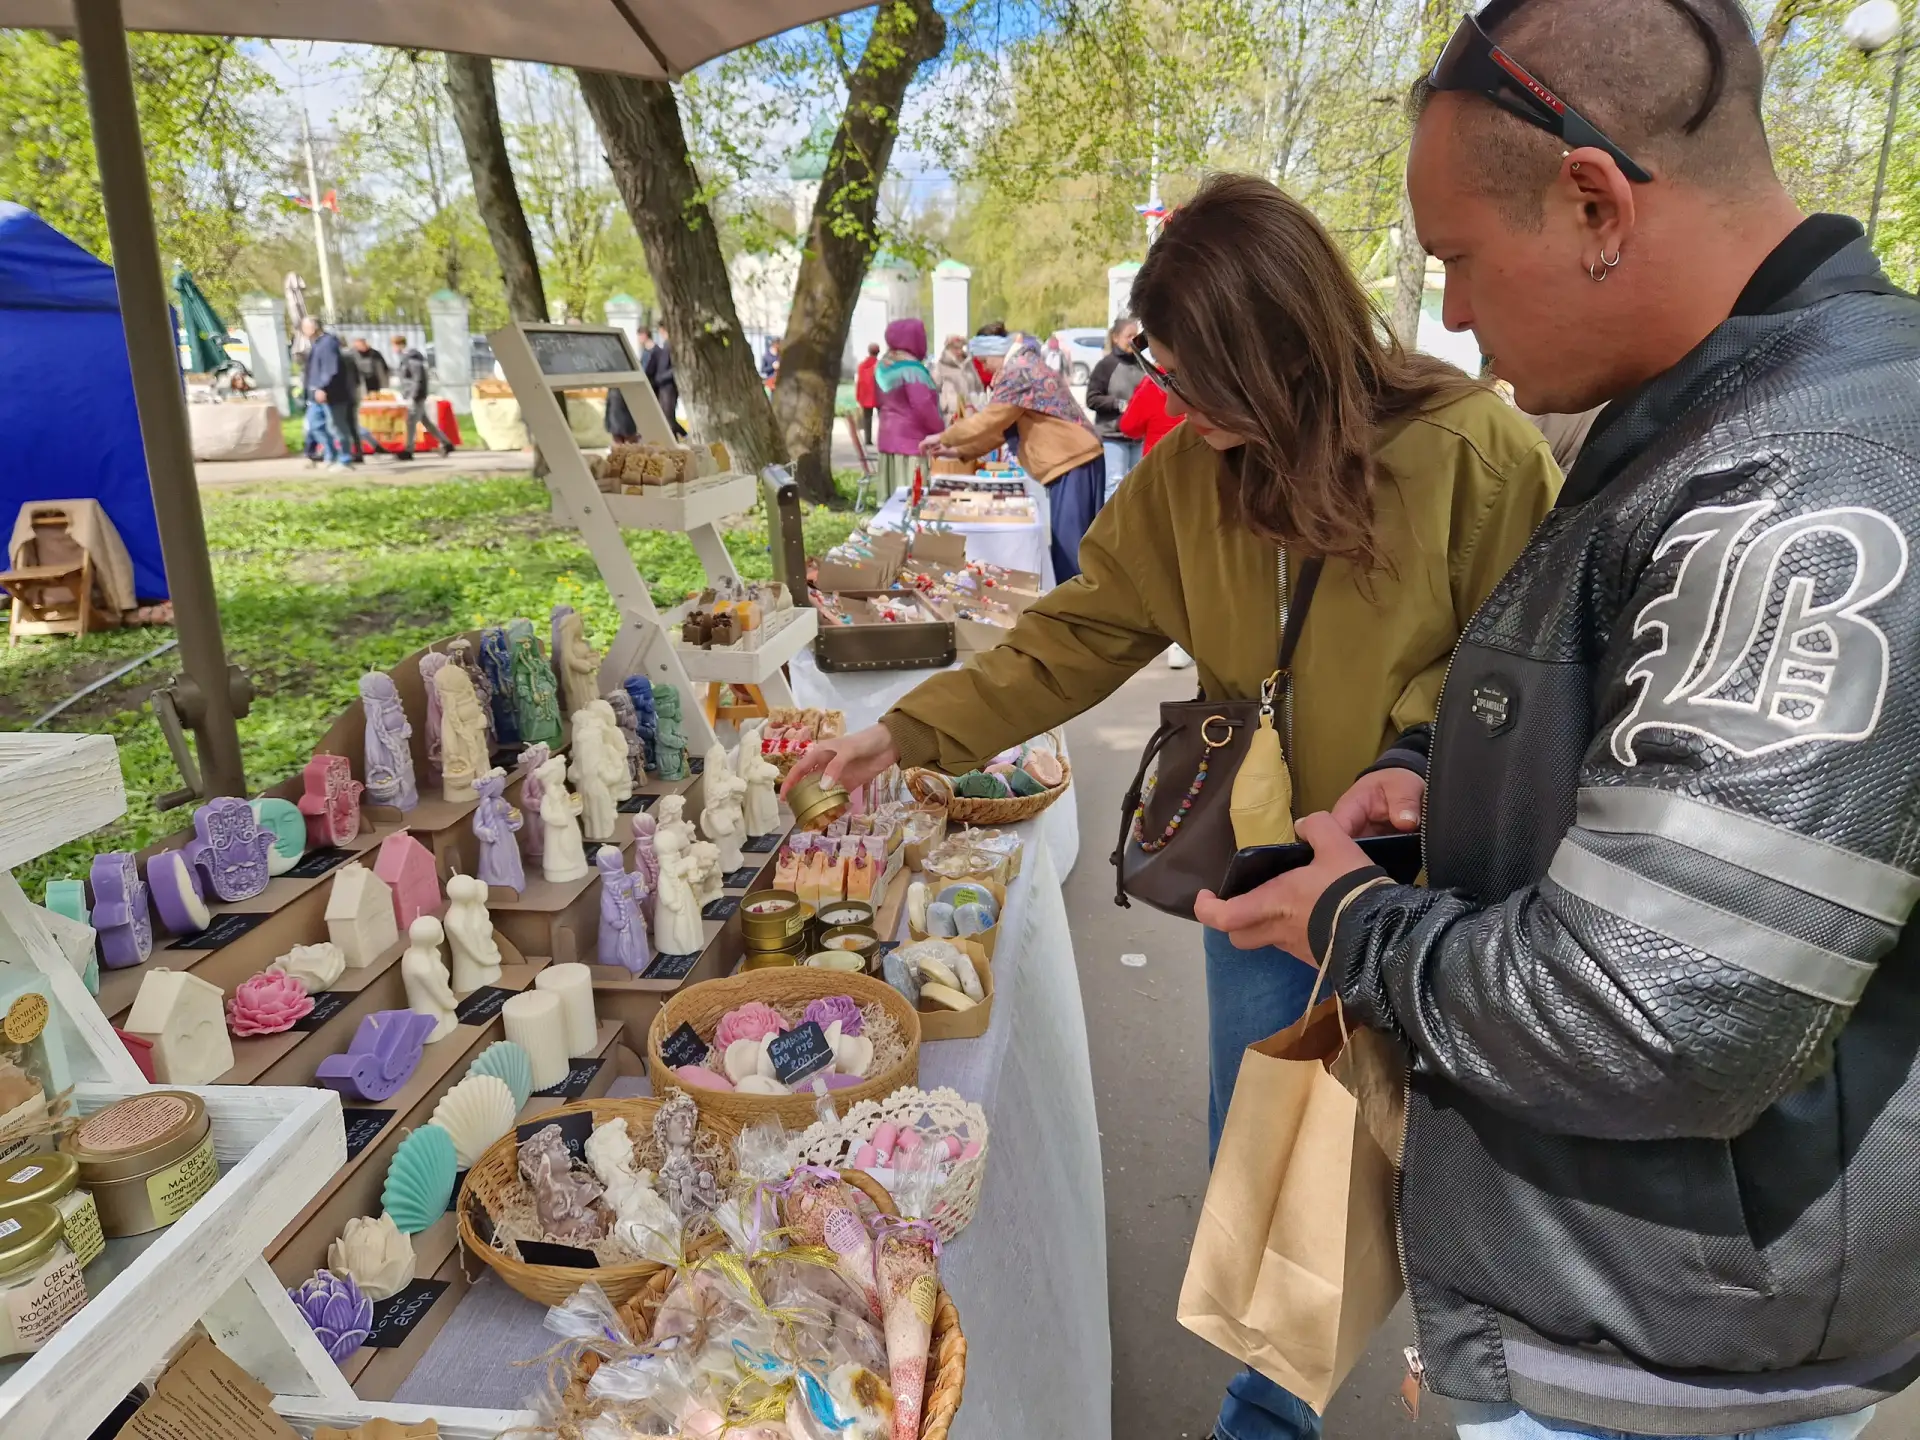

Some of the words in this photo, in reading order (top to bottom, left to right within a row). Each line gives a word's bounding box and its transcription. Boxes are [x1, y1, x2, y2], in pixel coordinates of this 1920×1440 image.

[1528, 81, 1557, 107] PRADA
[12, 1002, 41, 1026] РУЧНАЯ
[15, 1010, 43, 1034] РАБОТА
[180, 1148, 208, 1174] СВЕЧА
[65, 1202, 92, 1230] СВЕЧА
[43, 1257, 80, 1288] СВЕЧА
